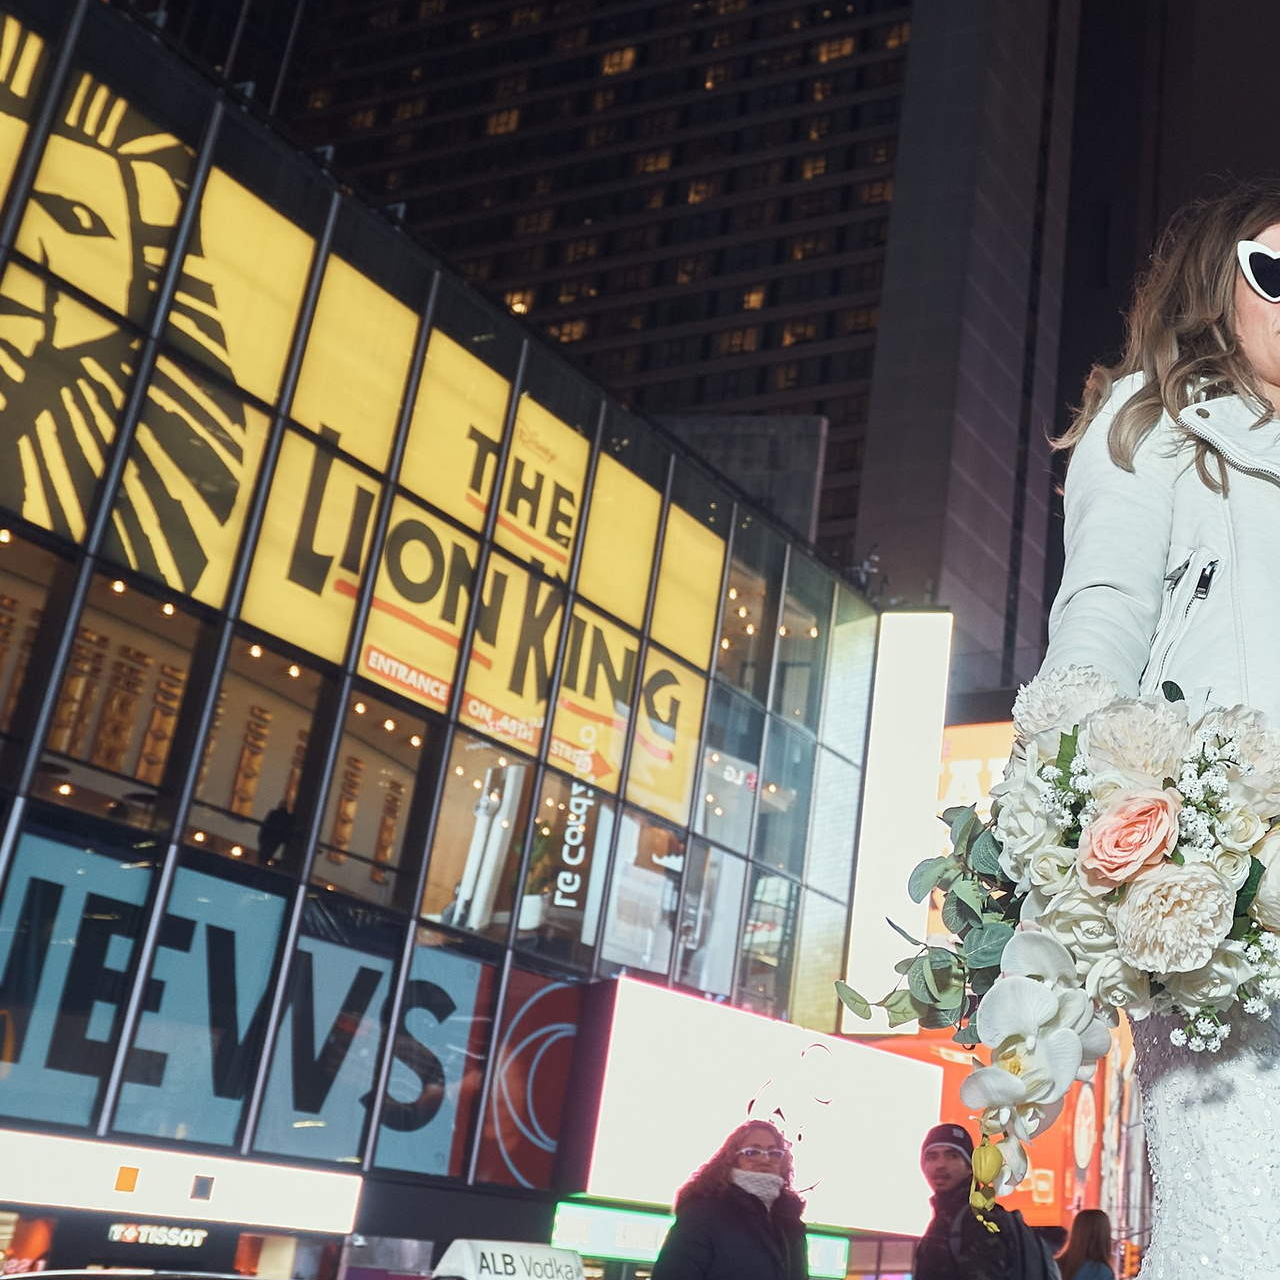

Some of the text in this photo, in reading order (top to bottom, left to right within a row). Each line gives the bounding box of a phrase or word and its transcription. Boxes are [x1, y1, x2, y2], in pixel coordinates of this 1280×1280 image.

[467, 424, 576, 549] THE
[287, 422, 681, 744] LION KING
[368, 650, 448, 702] ENTRANCE
[468, 699, 493, 723] ON
[138, 1224, 209, 1248] TISSOT
[479, 1251, 517, 1276] ALB
[520, 1254, 575, 1280] Vodka
